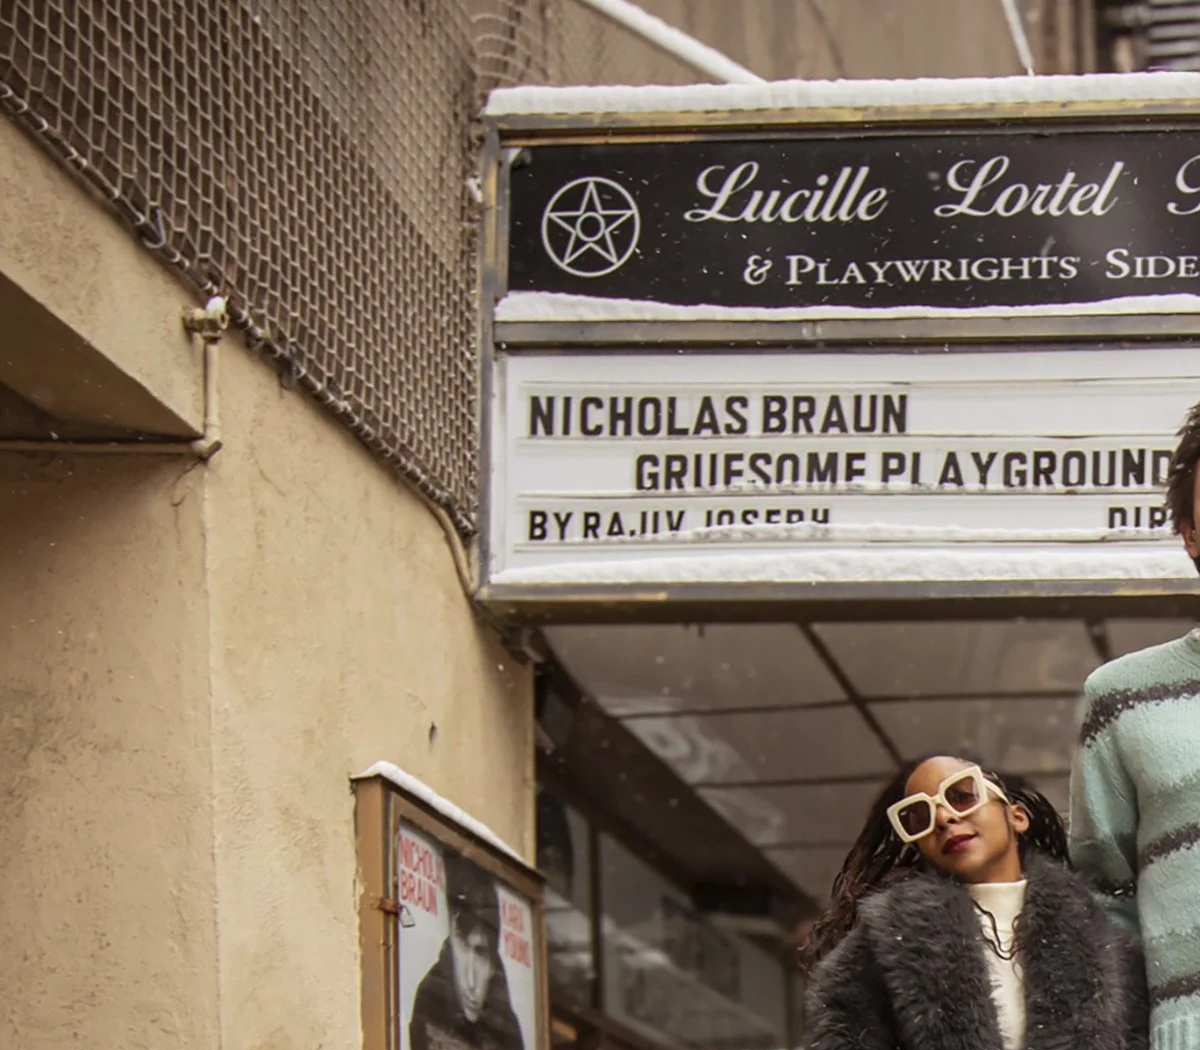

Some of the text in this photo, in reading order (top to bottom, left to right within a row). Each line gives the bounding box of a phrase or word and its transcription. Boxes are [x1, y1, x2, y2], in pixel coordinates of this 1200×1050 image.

[683, 160, 889, 223] Lucille
[934, 155, 1125, 218] Lortel
[743, 254, 773, 285] &
[529, 393, 909, 437] NICHOLAS BRAUN
[635, 452, 867, 491] GRUESOME
[881, 448, 1173, 489] PLAYGROUND
[528, 509, 574, 541] BY
